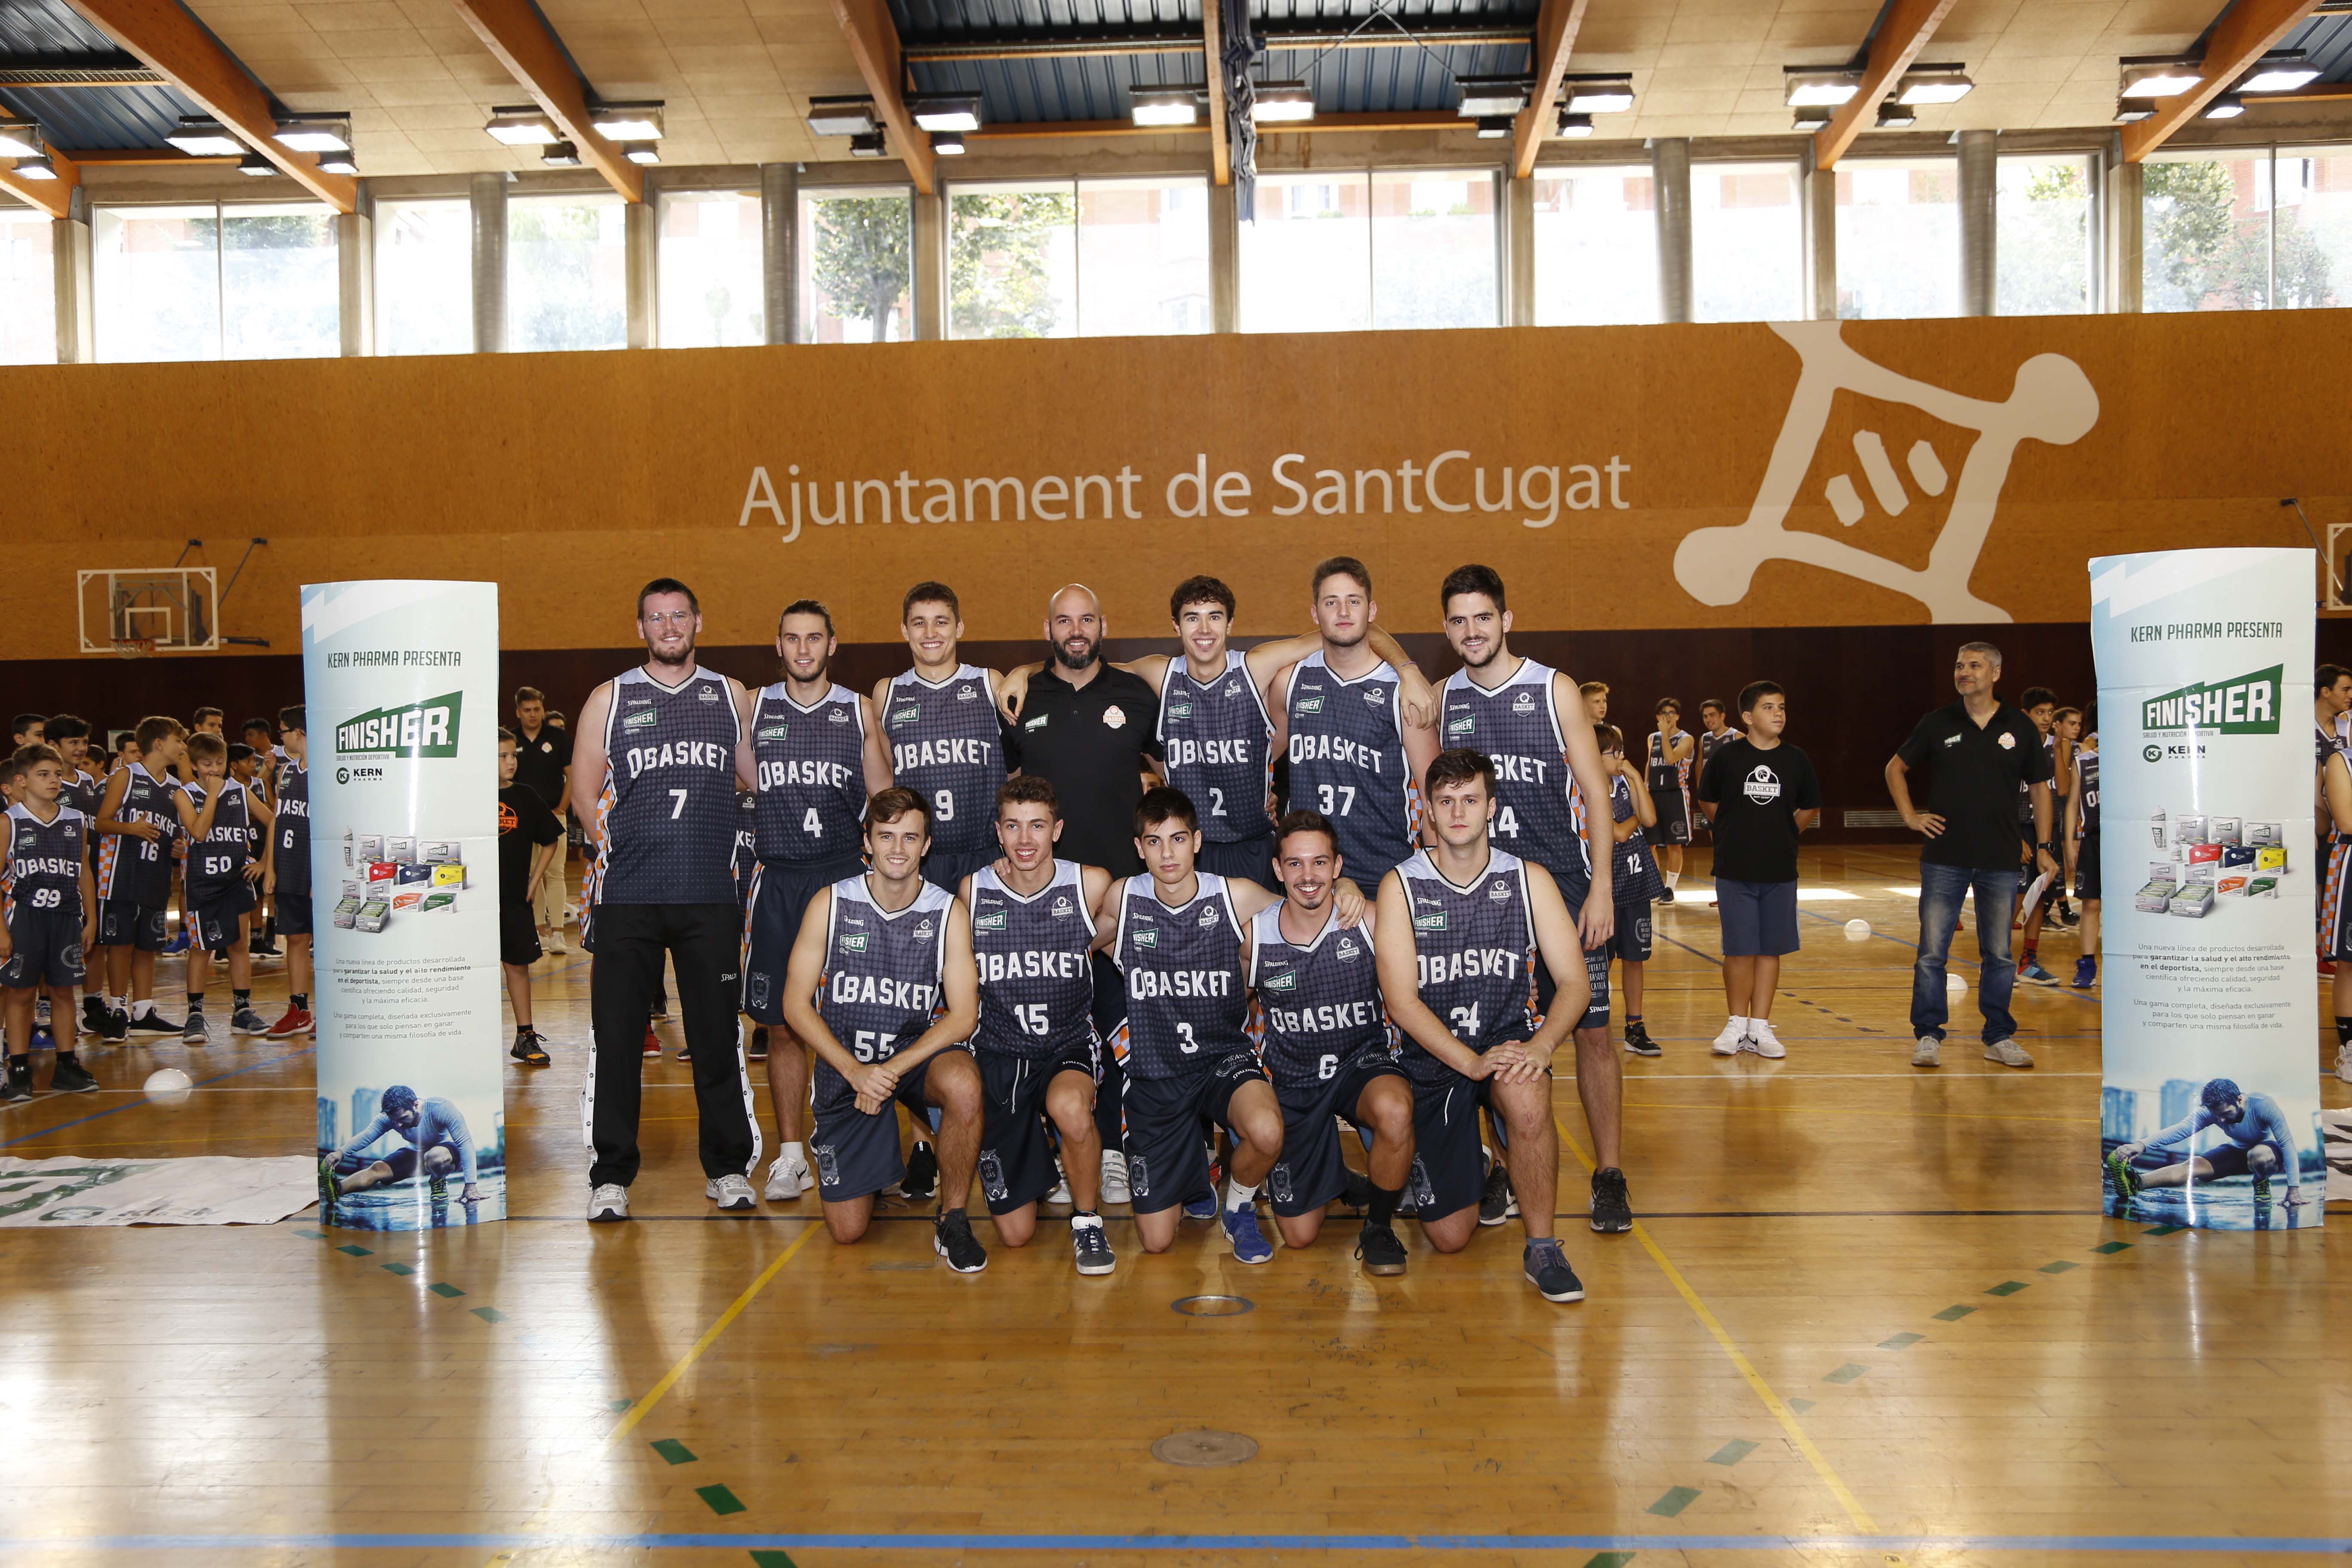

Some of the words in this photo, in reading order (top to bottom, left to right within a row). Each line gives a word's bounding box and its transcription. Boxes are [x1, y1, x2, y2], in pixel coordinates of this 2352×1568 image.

[737, 464, 1142, 544] Ajuntament
[1166, 453, 1253, 518] de
[1272, 450, 1631, 529] SantCugat
[2131, 625, 2162, 642] KERN
[2167, 622, 2222, 640] PHARMA
[2227, 622, 2282, 638] PRESENTA
[328, 652, 349, 668] KERN
[353, 651, 398, 666] PHARMA
[404, 651, 461, 666] PRESENTA
[1365, 694, 1384, 702] BASKET
[2147, 680, 2271, 727] FINISHER
[339, 706, 450, 750] FINISHER
[625, 712, 653, 725] FINISHER
[759, 727, 784, 737] FINISHER
[627, 741, 727, 778] QBASKET
[1290, 733, 1381, 773] QBASKET
[759, 760, 852, 792] QBASKET
[1660, 774, 1663, 785] 1
[669, 789, 687, 819] 7
[935, 790, 954, 821] 9
[1209, 787, 1227, 816] 2
[1317, 784, 1355, 816] 37
[803, 808, 823, 838] 4
[249, 828, 257, 839] 8
[283, 829, 294, 848] 6
[141, 841, 159, 861] 16
[16, 858, 82, 878] QBASKET
[205, 856, 231, 875] 50
[1627, 853, 1642, 875] 12
[32, 888, 61, 908] 99
[1417, 897, 1441, 906] SPALDING
[977, 915, 1003, 926] FINISHER
[1133, 913, 1153, 922] SPALDING
[1415, 916, 1443, 927] FINISHER
[1338, 949, 1358, 957] BASKET
[2160, 964, 2201, 973] deportista,
[1131, 967, 1231, 1000] QBASKET
[1265, 976, 1292, 988] FINISHER
[2171, 1001, 2208, 1010] completa,
[1014, 1004, 1048, 1035] 15
[2148, 1020, 2187, 1029] comparten
[855, 1030, 897, 1062] 55
[1177, 1023, 1199, 1054] 3
[1319, 1054, 1337, 1079] 6
